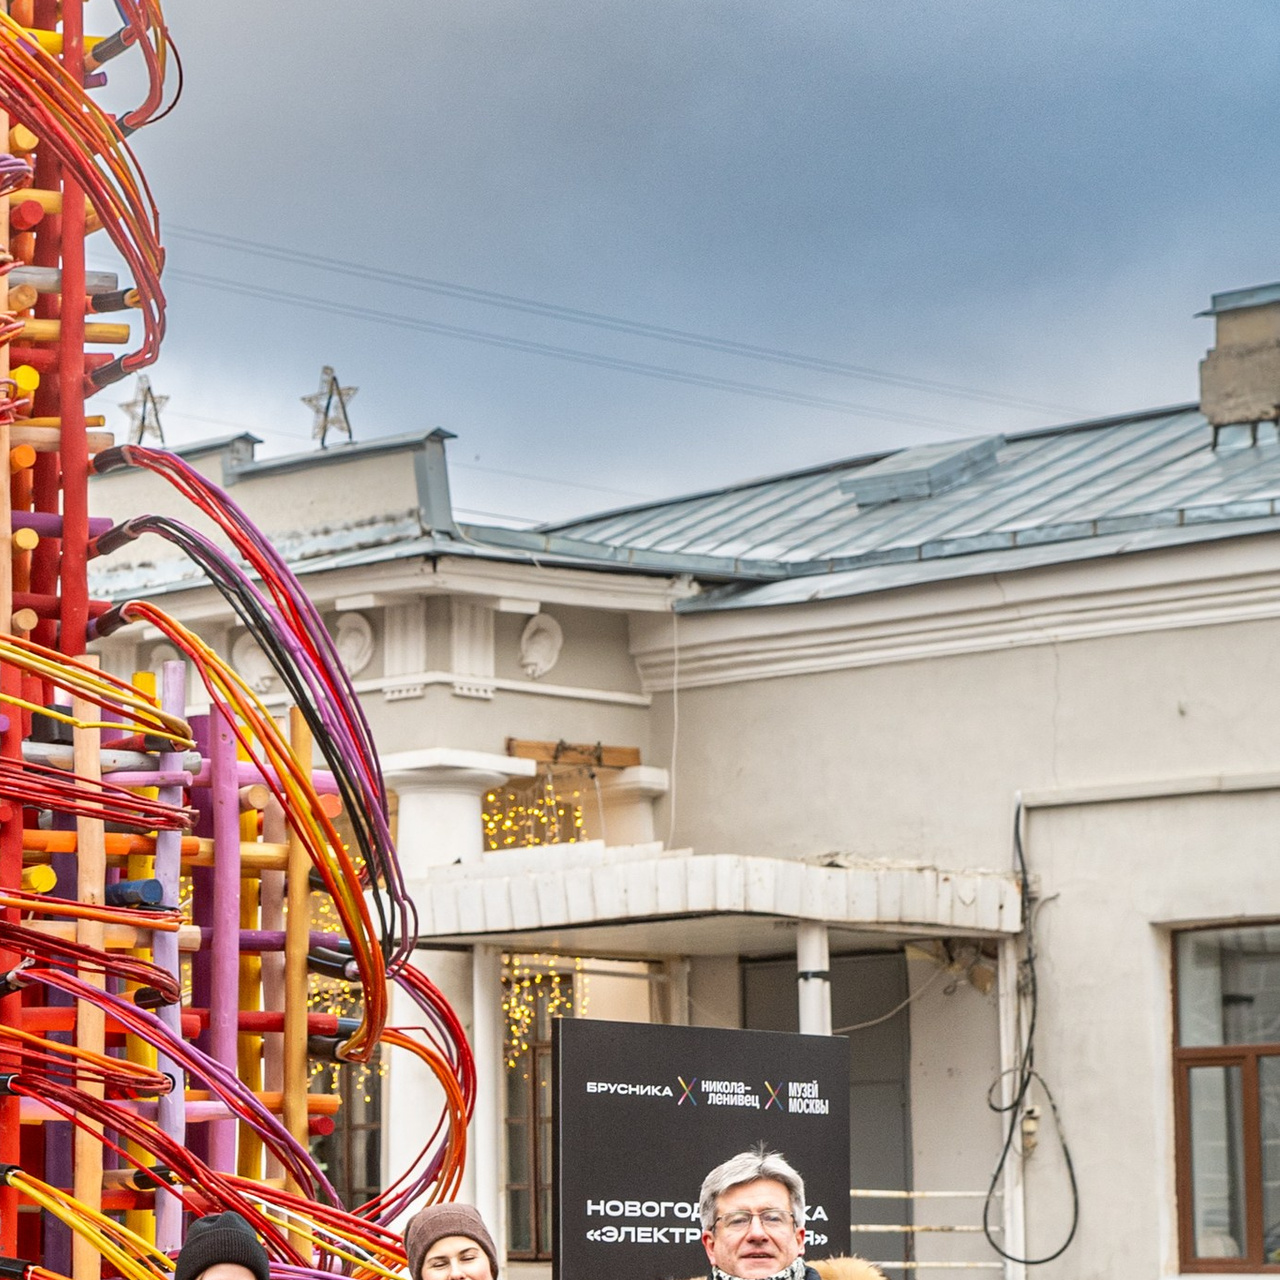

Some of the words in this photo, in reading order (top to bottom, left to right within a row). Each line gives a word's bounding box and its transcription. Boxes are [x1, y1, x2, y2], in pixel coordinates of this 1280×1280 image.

[586, 1081, 674, 1097] БРУСНИКА
[788, 1080, 819, 1099] МУЗЕЙ
[788, 1097, 829, 1115] МОСКВЫ
[586, 1199, 701, 1222] НОВОГОД
